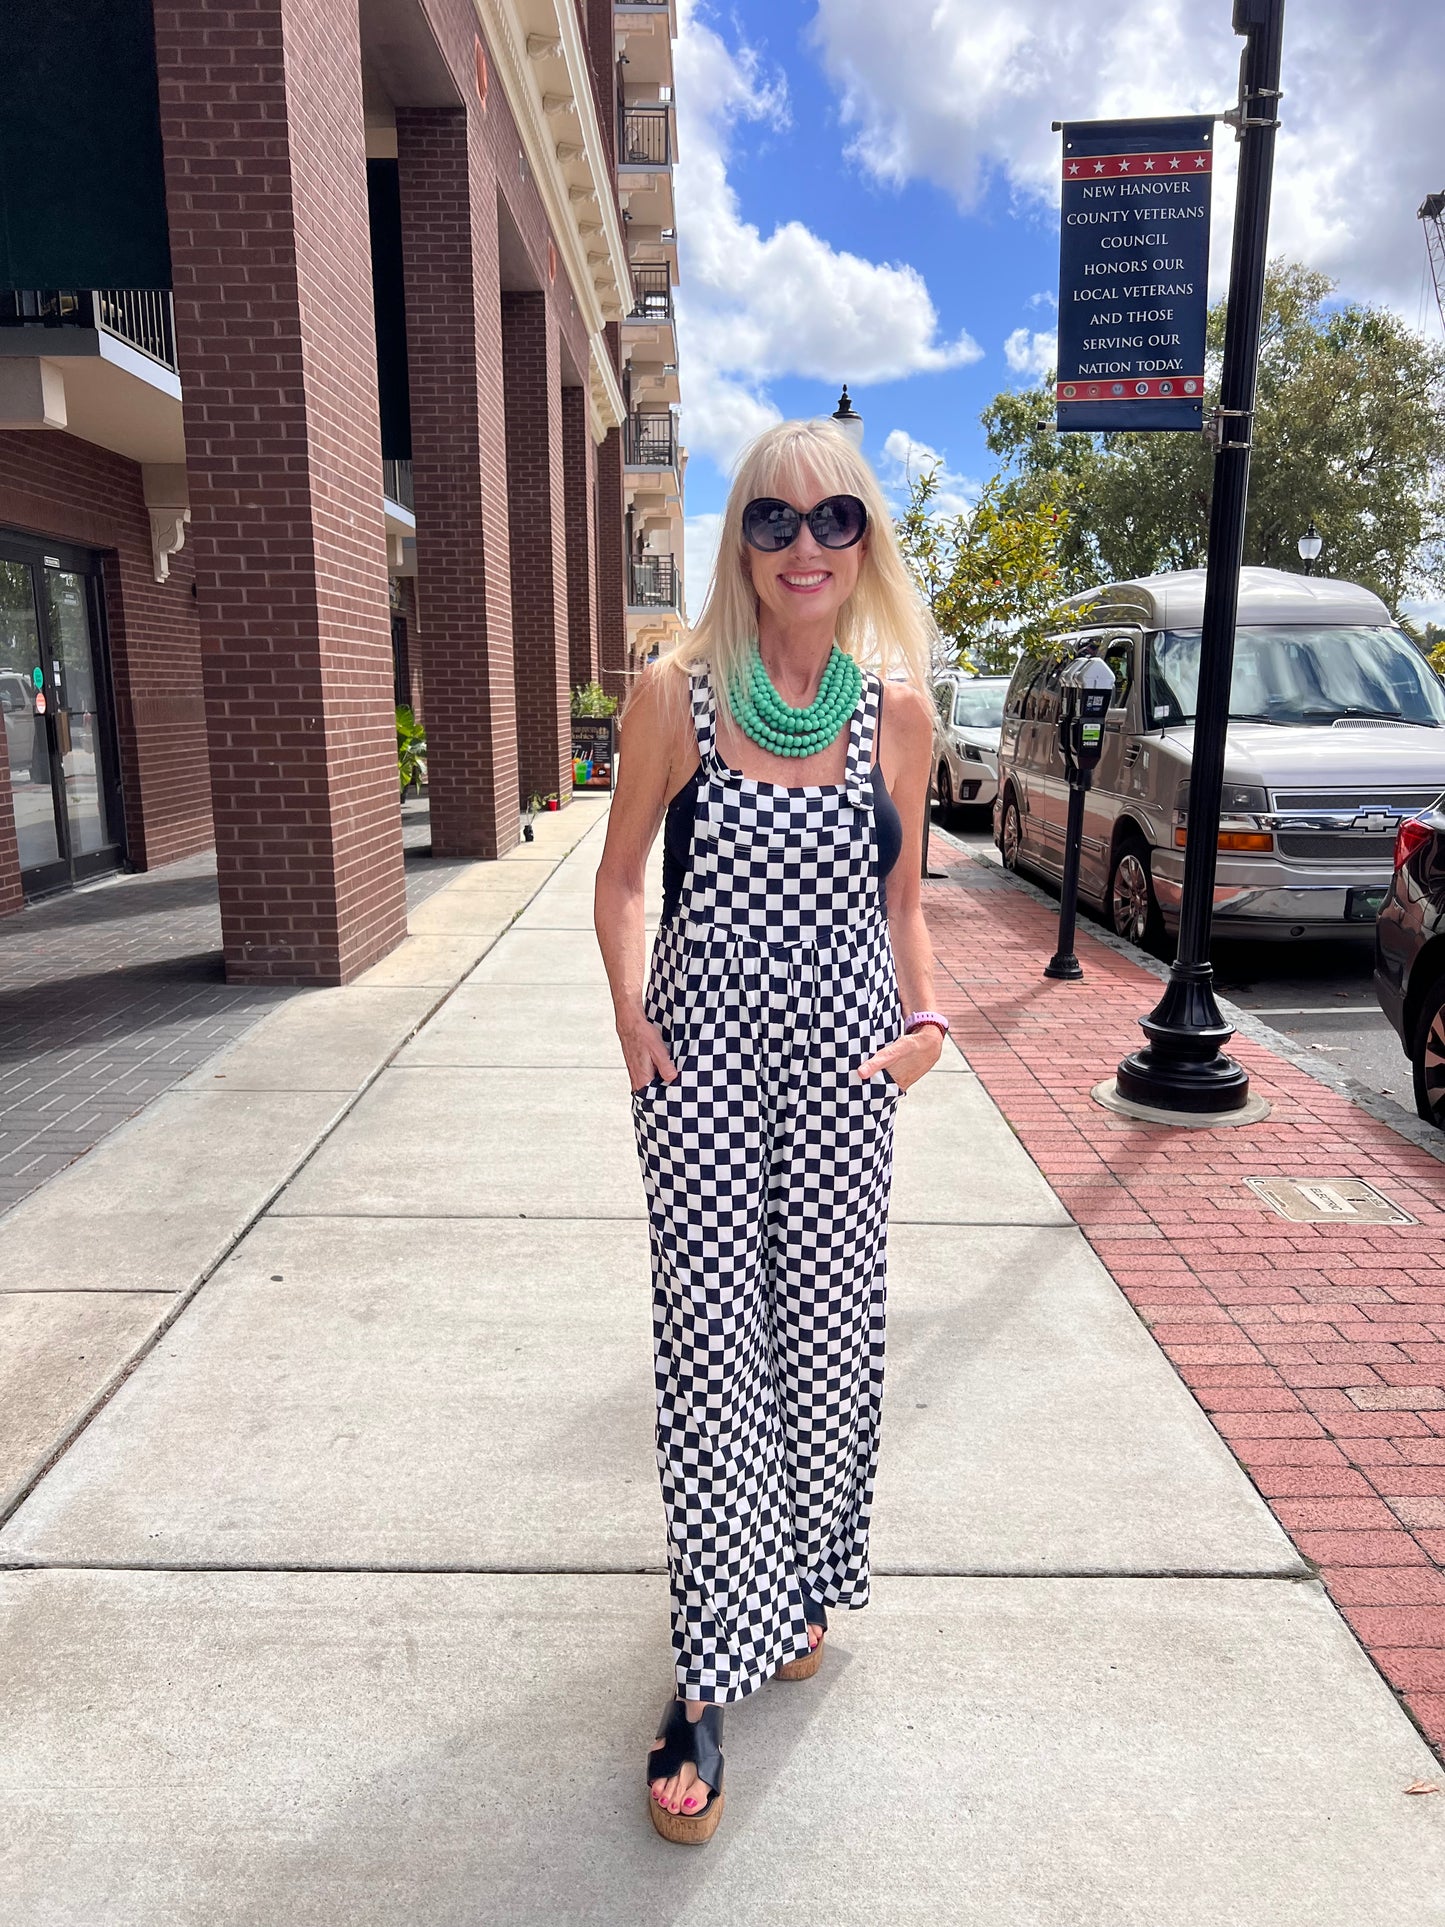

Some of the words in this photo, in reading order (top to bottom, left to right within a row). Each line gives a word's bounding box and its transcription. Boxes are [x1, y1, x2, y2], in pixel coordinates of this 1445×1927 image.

[1083, 185, 1115, 198] NEW
[1121, 182, 1190, 195] HANOVER
[1067, 210, 1129, 225] COUNTY
[1134, 206, 1204, 220] VETERANS
[1101, 234, 1168, 248] COUNCIL
[1085, 260, 1147, 275] HONORS
[1153, 259, 1184, 270] OUR
[1074, 288, 1118, 301] LOCAL
[1124, 284, 1193, 297] VETERANS
[1090, 313, 1122, 325] AND
[1127, 309, 1173, 322] THOSE
[1083, 336, 1142, 350] SERVING
[1149, 334, 1180, 346] OUR
[1079, 362, 1130, 374] NATION
[1136, 359, 1183, 372] TODAY.
[1310, 1187, 1342, 1211] ELECTRIC
